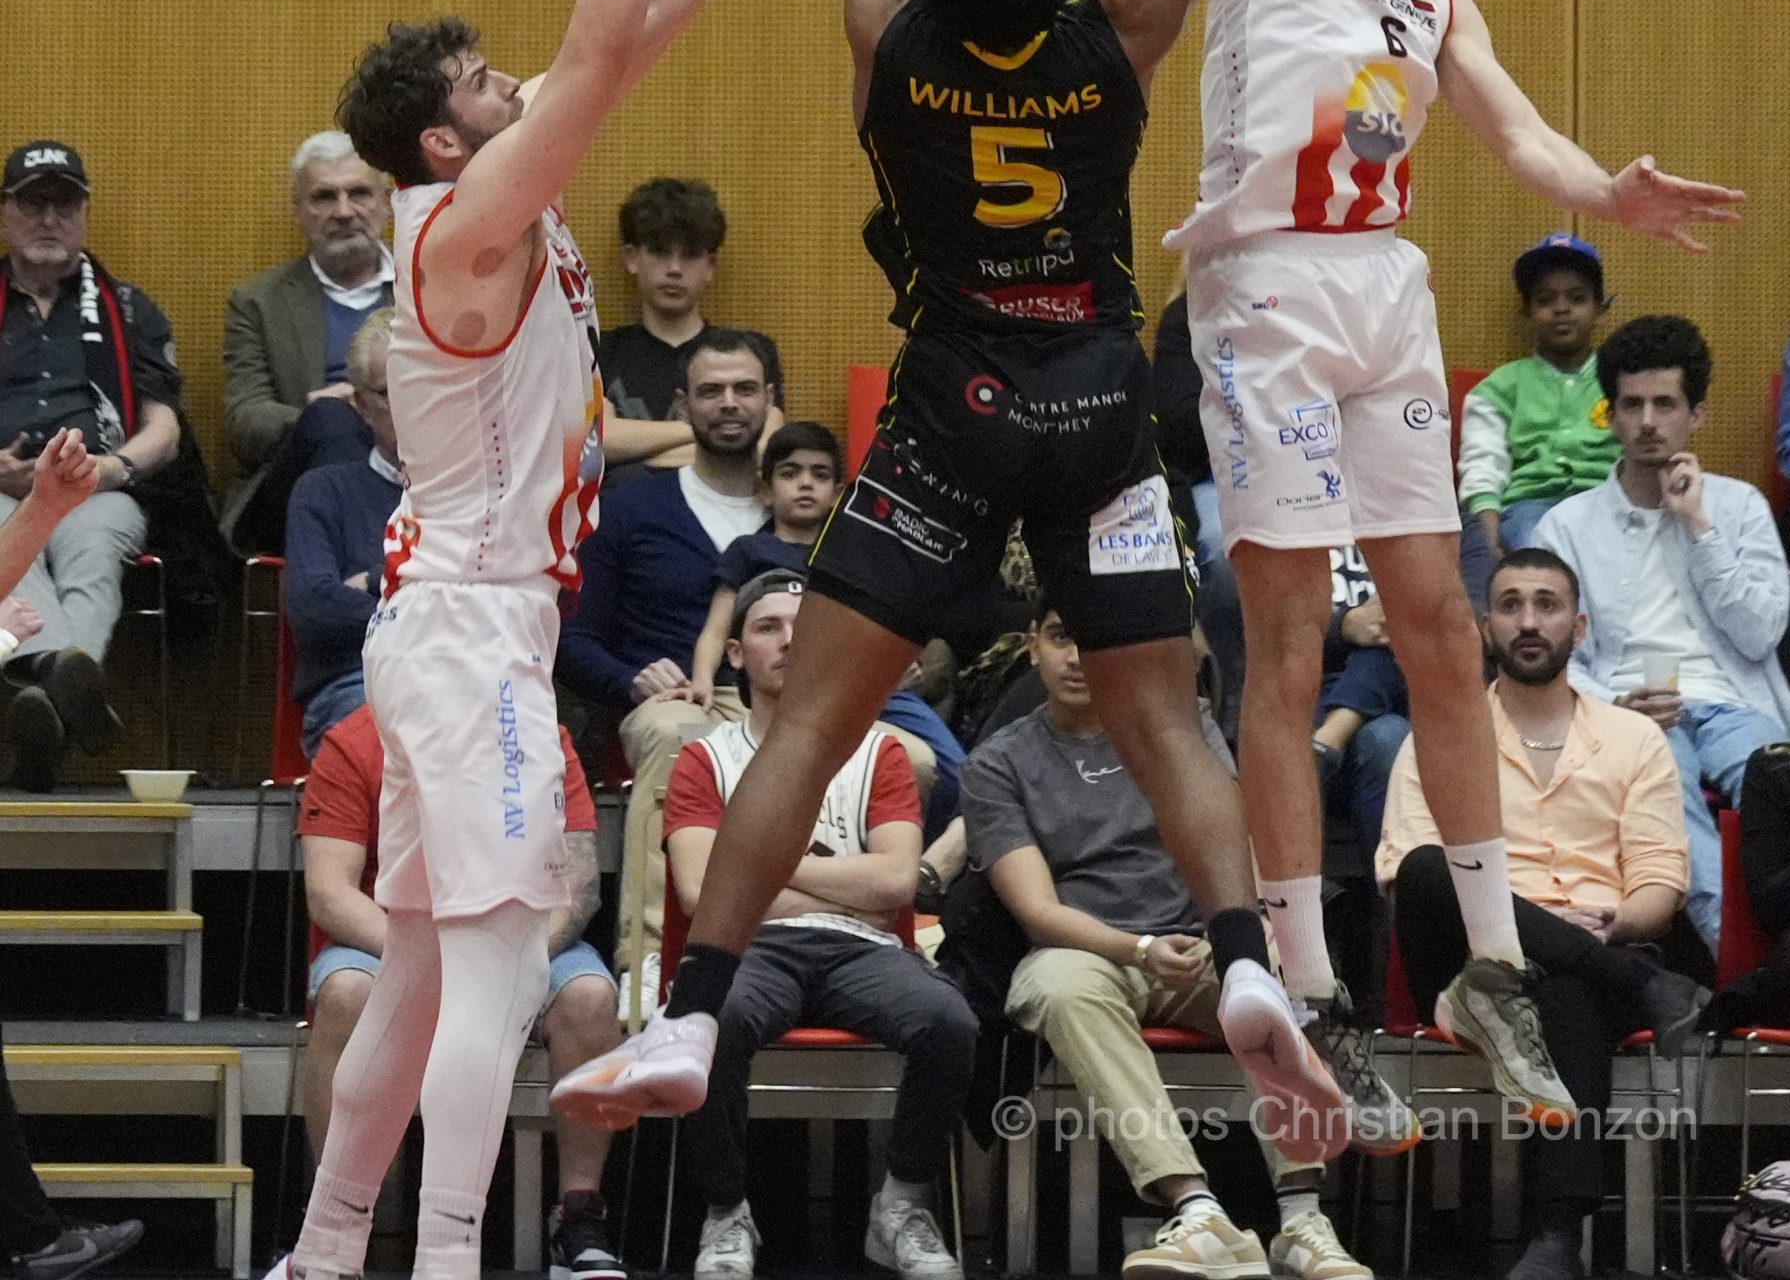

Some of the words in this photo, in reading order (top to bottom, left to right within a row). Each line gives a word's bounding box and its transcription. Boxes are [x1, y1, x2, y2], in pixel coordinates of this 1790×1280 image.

[1380, 16, 1408, 58] 6
[909, 76, 1102, 120] WILLIAMS
[970, 125, 1068, 229] 5
[1217, 336, 1245, 446] Logistics
[1279, 422, 1329, 445] EXCO
[1226, 447, 1249, 491] NV
[1098, 533, 1129, 550] LES
[496, 679, 525, 794] Logistics
[500, 797, 525, 839] NV
